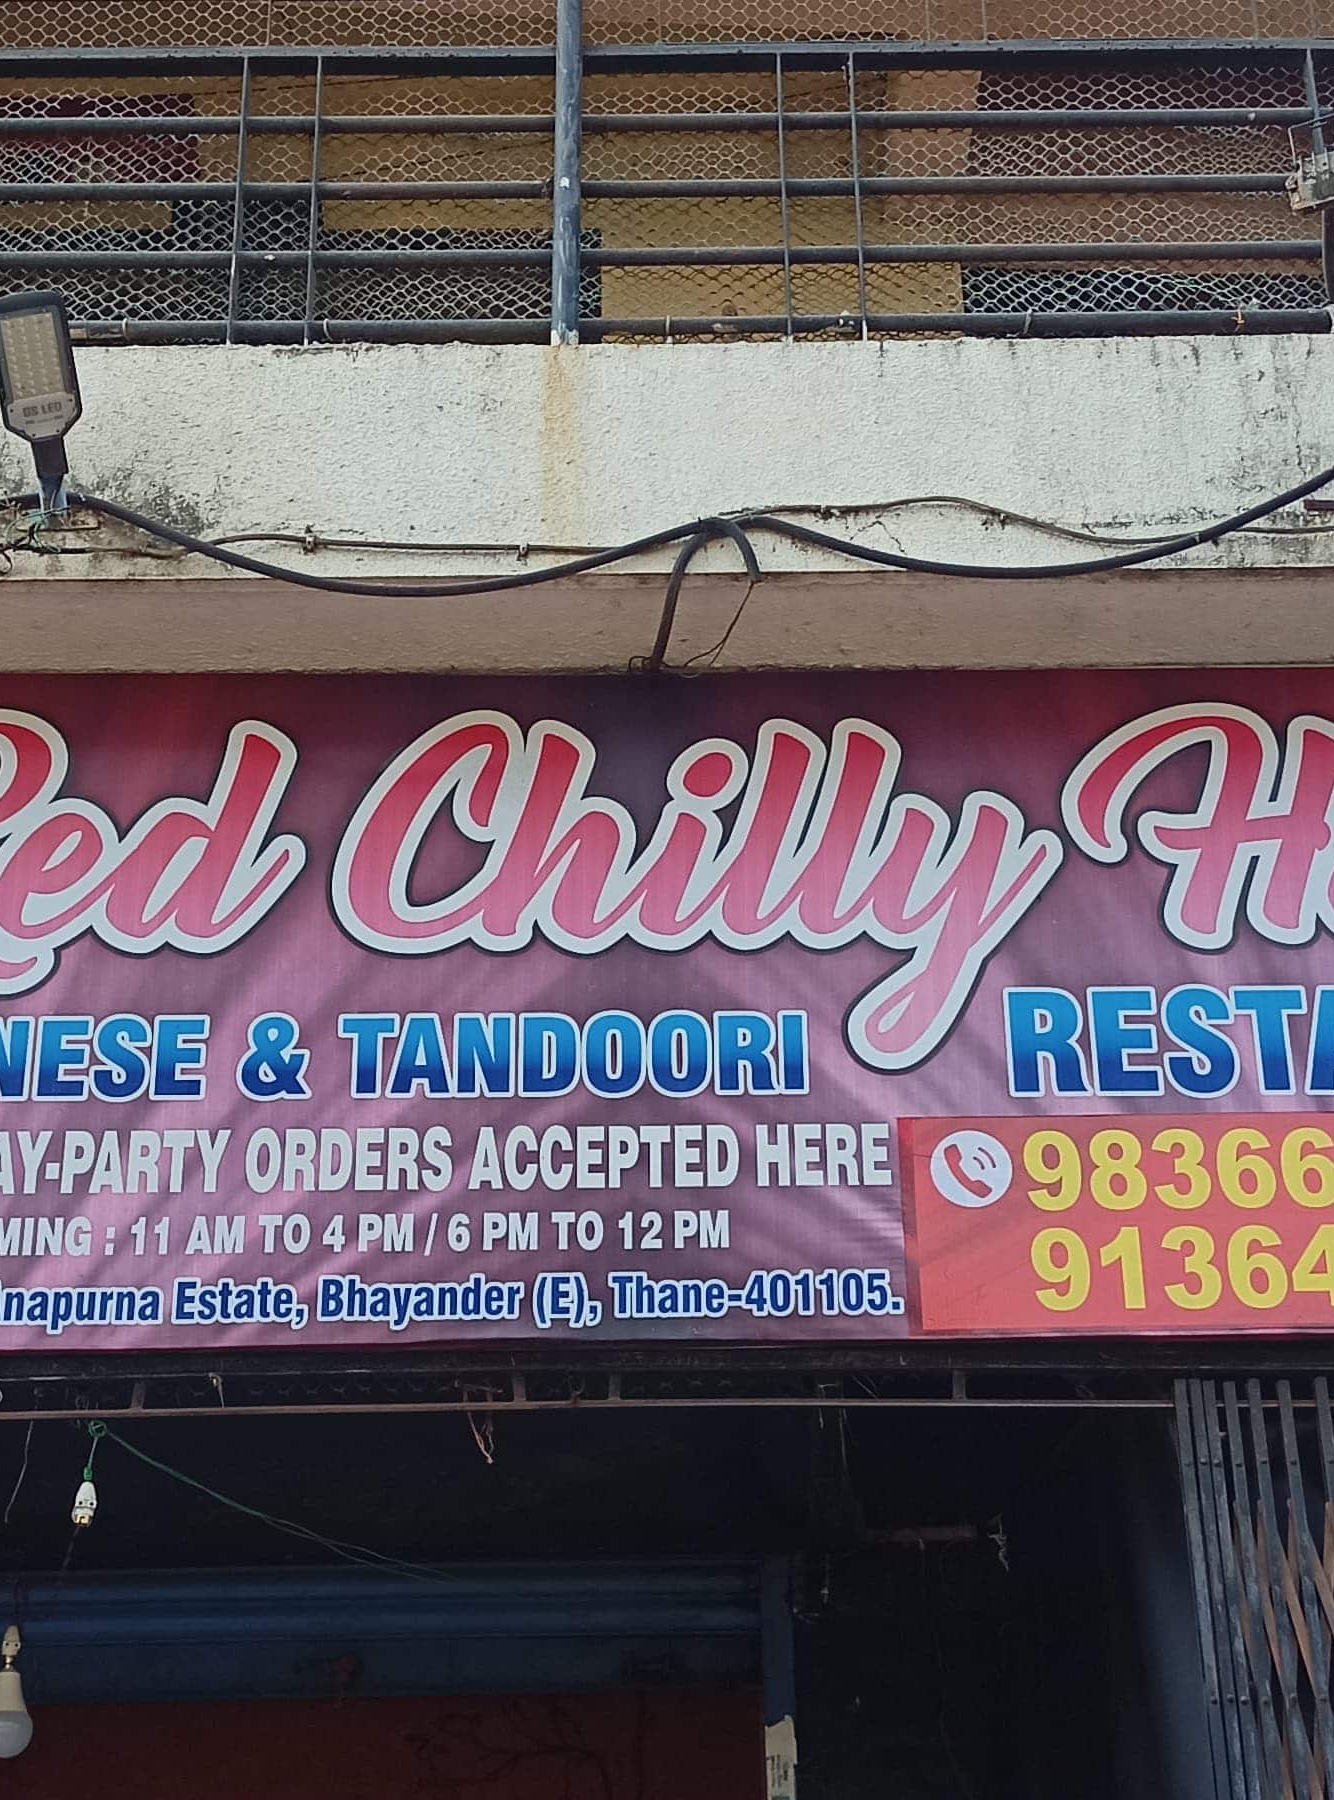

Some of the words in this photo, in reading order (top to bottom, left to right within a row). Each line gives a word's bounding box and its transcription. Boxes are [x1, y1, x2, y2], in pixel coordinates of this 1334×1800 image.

[332, 710, 1063, 1070] Chilly
[238, 1013, 311, 1101] &
[339, 1009, 809, 1099] TANDOORI
[245, 1126, 453, 1192] ORDERS
[468, 1125, 739, 1191] ACCEPTED
[756, 1123, 892, 1188] HERE
[130, 1217, 170, 1256] 11
[185, 1215, 245, 1255] AM
[259, 1214, 310, 1253] TO
[322, 1213, 346, 1253] 4
[358, 1213, 414, 1253] PM
[447, 1212, 471, 1252] 6
[483, 1212, 538, 1252] PM
[551, 1211, 604, 1251] TO
[618, 1211, 663, 1250] 12
[674, 1209, 731, 1250] PM
[171, 1277, 307, 1331] Estate,
[317, 1273, 525, 1331] Bhayander
[532, 1272, 602, 1329] (E),
[610, 1269, 905, 1320] Thane-401105.
